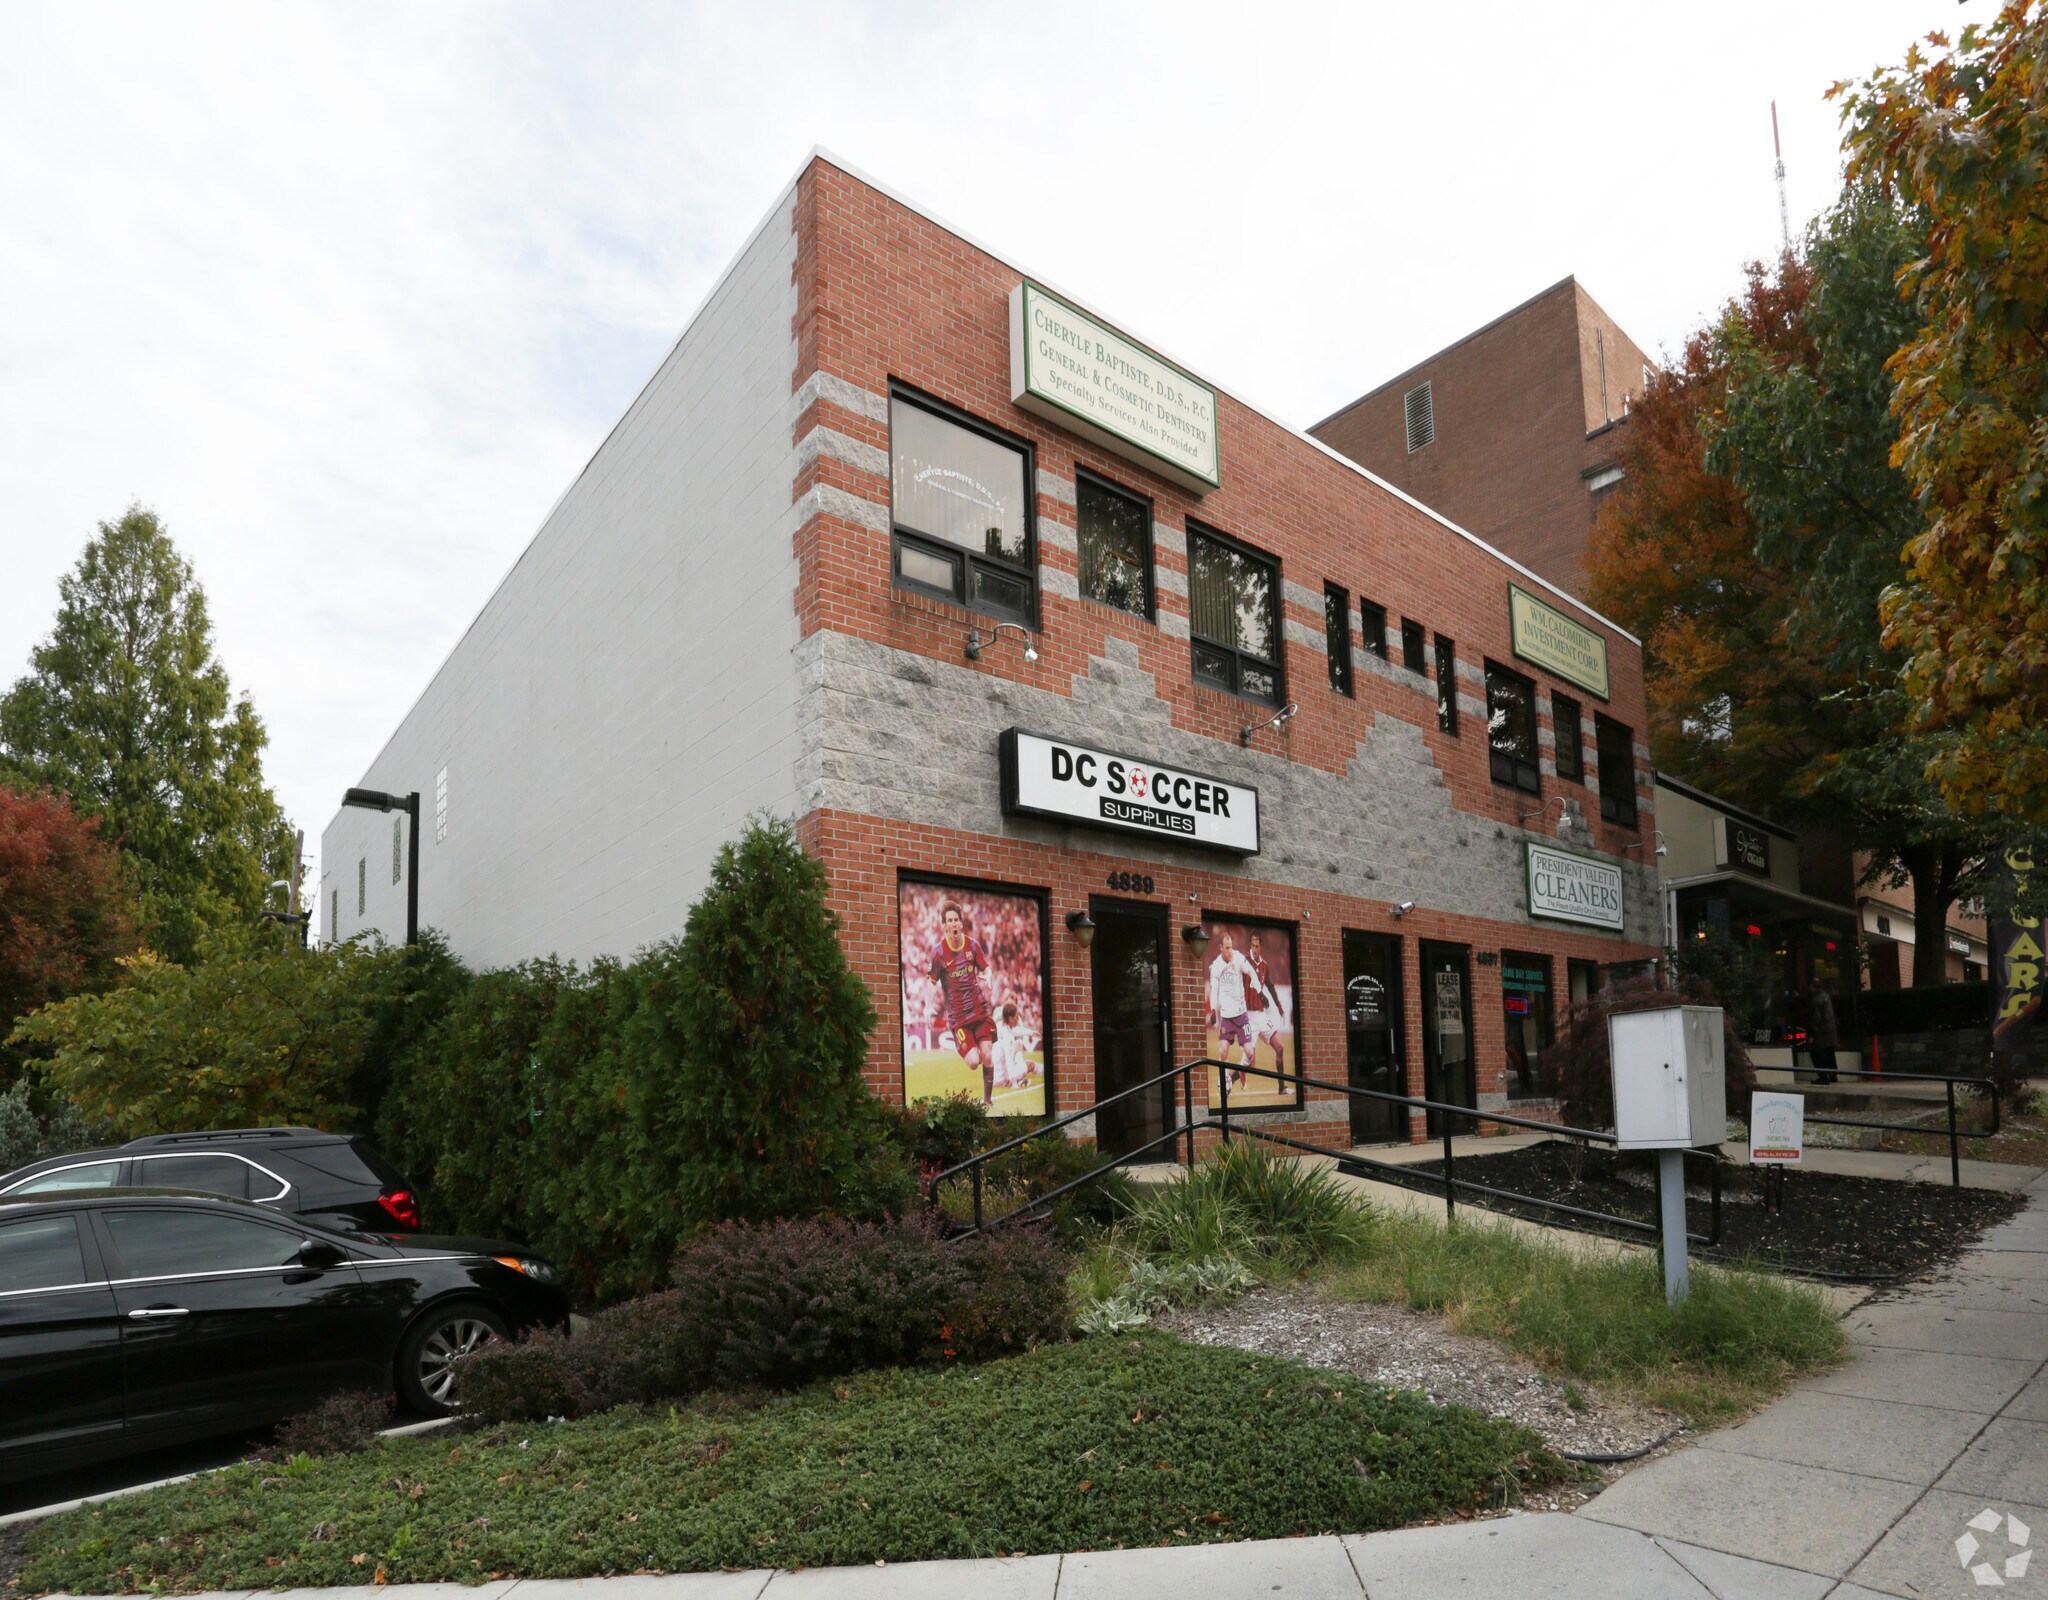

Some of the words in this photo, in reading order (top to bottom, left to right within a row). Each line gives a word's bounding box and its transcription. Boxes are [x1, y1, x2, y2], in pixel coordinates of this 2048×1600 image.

[1035, 308, 1091, 356] CHERYLE
[1096, 342, 1153, 392] BAPTISTE,
[1192, 401, 1209, 421] P.C.
[1039, 340, 1088, 379] GENERAL
[1092, 370, 1101, 386] &
[1105, 376, 1154, 414] COSMETIC
[1157, 404, 1207, 444] DENTISTRY
[1049, 370, 1095, 407] Specialty
[1098, 396, 1136, 426] Services
[1140, 419, 1158, 436] Also
[1161, 432, 1198, 457] Provided
[1523, 620, 1576, 660] INVESTMENT
[1577, 651, 1599, 673] CORP.
[1548, 617, 1591, 652] CALOMIRIS
[1051, 746, 1097, 788] DC
[1104, 802, 1194, 832] SUPPLIES
[1106, 871, 1155, 894] 4839
[1536, 856, 1584, 879] PRESIDENT
[1585, 868, 1607, 885] VALET
[1609, 874, 1615, 887] II
[1534, 872, 1618, 911] CLEANERS
[949, 966, 969, 978] unicef
[1221, 973, 1233, 984] AIG
[1437, 974, 1459, 985] LEASE
[1505, 999, 1526, 1011] OPEN
[955, 1028, 966, 1045] 10
[1242, 1024, 1251, 1036] 10
